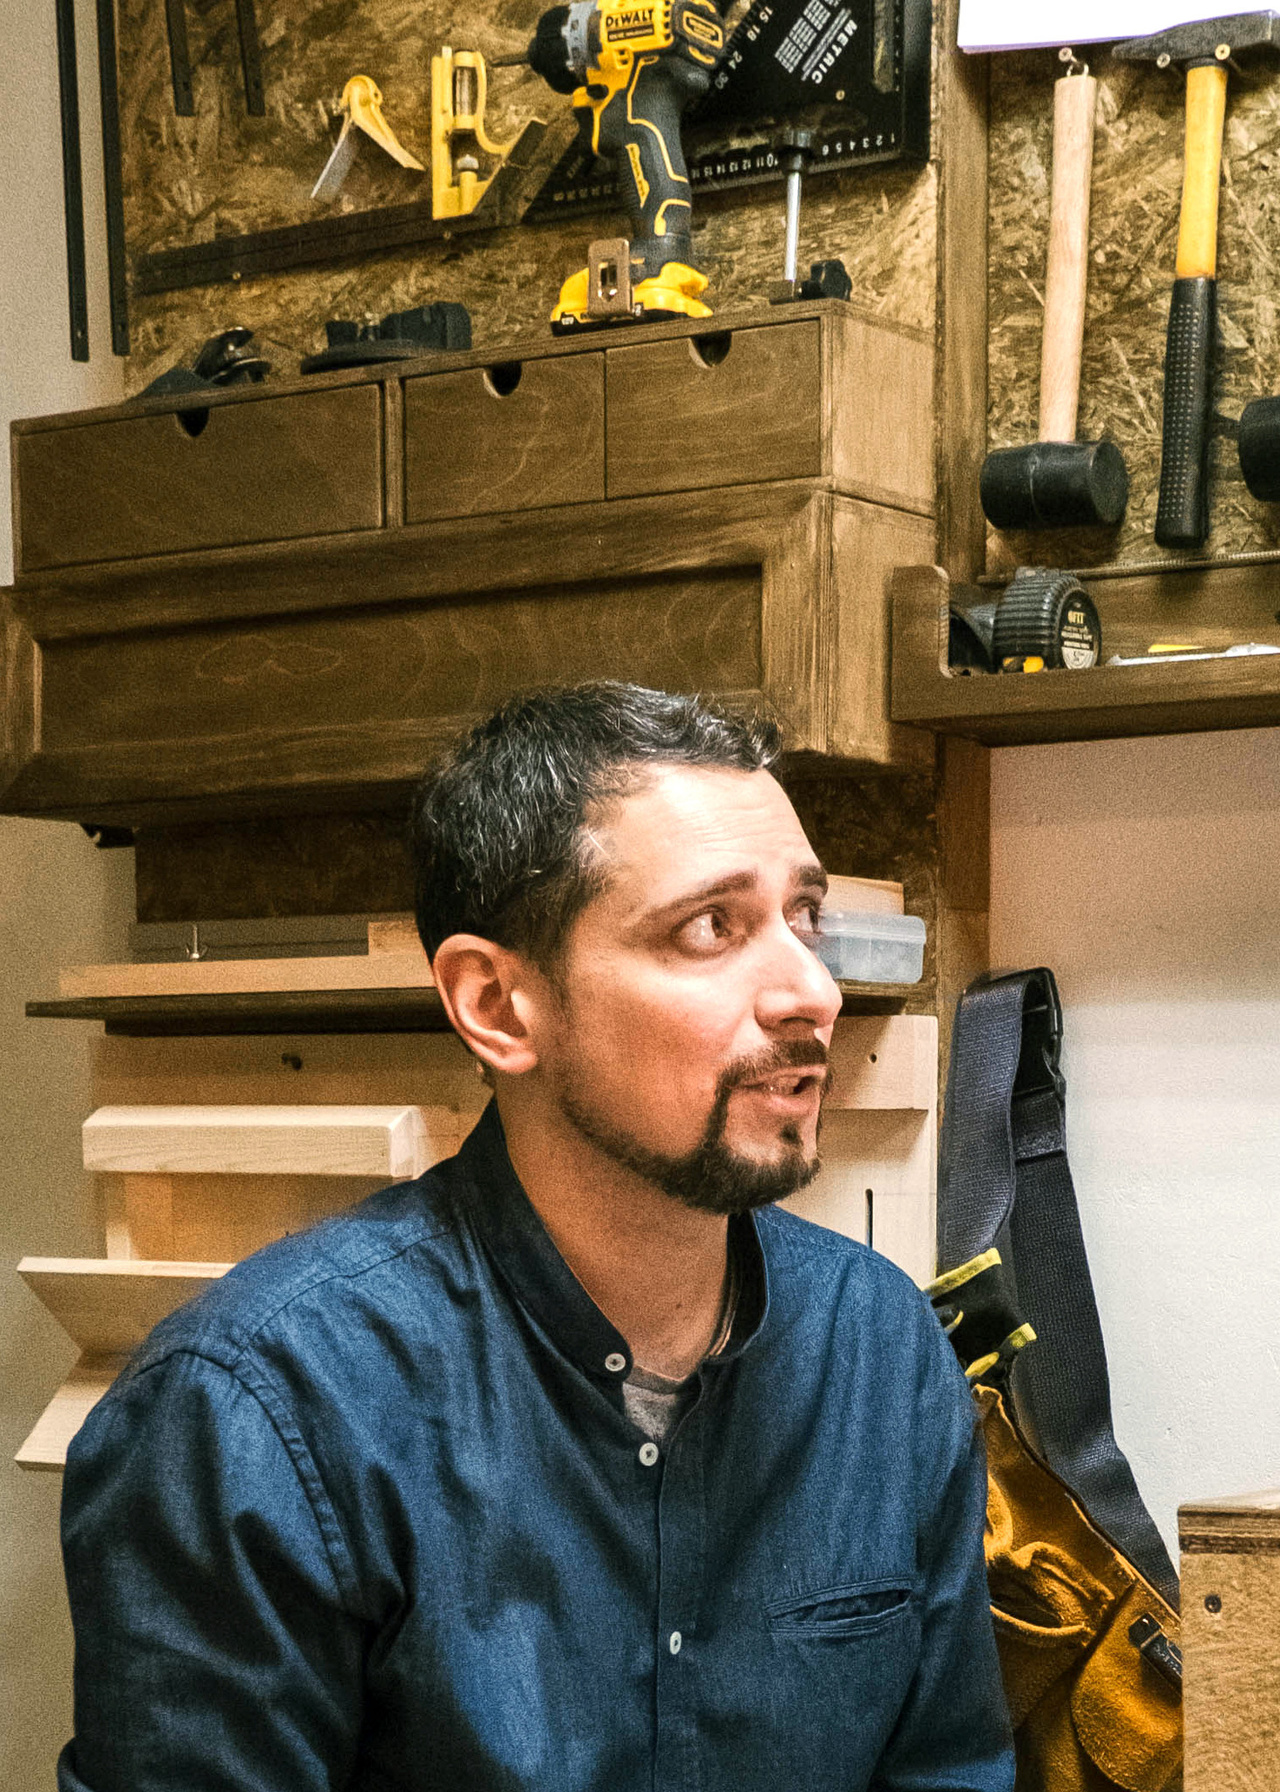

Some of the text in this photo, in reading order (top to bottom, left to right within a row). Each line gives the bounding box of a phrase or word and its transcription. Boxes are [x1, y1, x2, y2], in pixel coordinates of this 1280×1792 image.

[605, 9, 654, 27] DEWALT
[812, 19, 858, 84] METRIC
[849, 140, 856, 151] 4
[862, 137, 870, 149] 3
[876, 134, 883, 147] 2
[822, 144, 829, 156] 6
[835, 142, 842, 154] 5
[716, 164, 726, 175] 14
[729, 161, 739, 173] 13
[742, 159, 751, 170] 12
